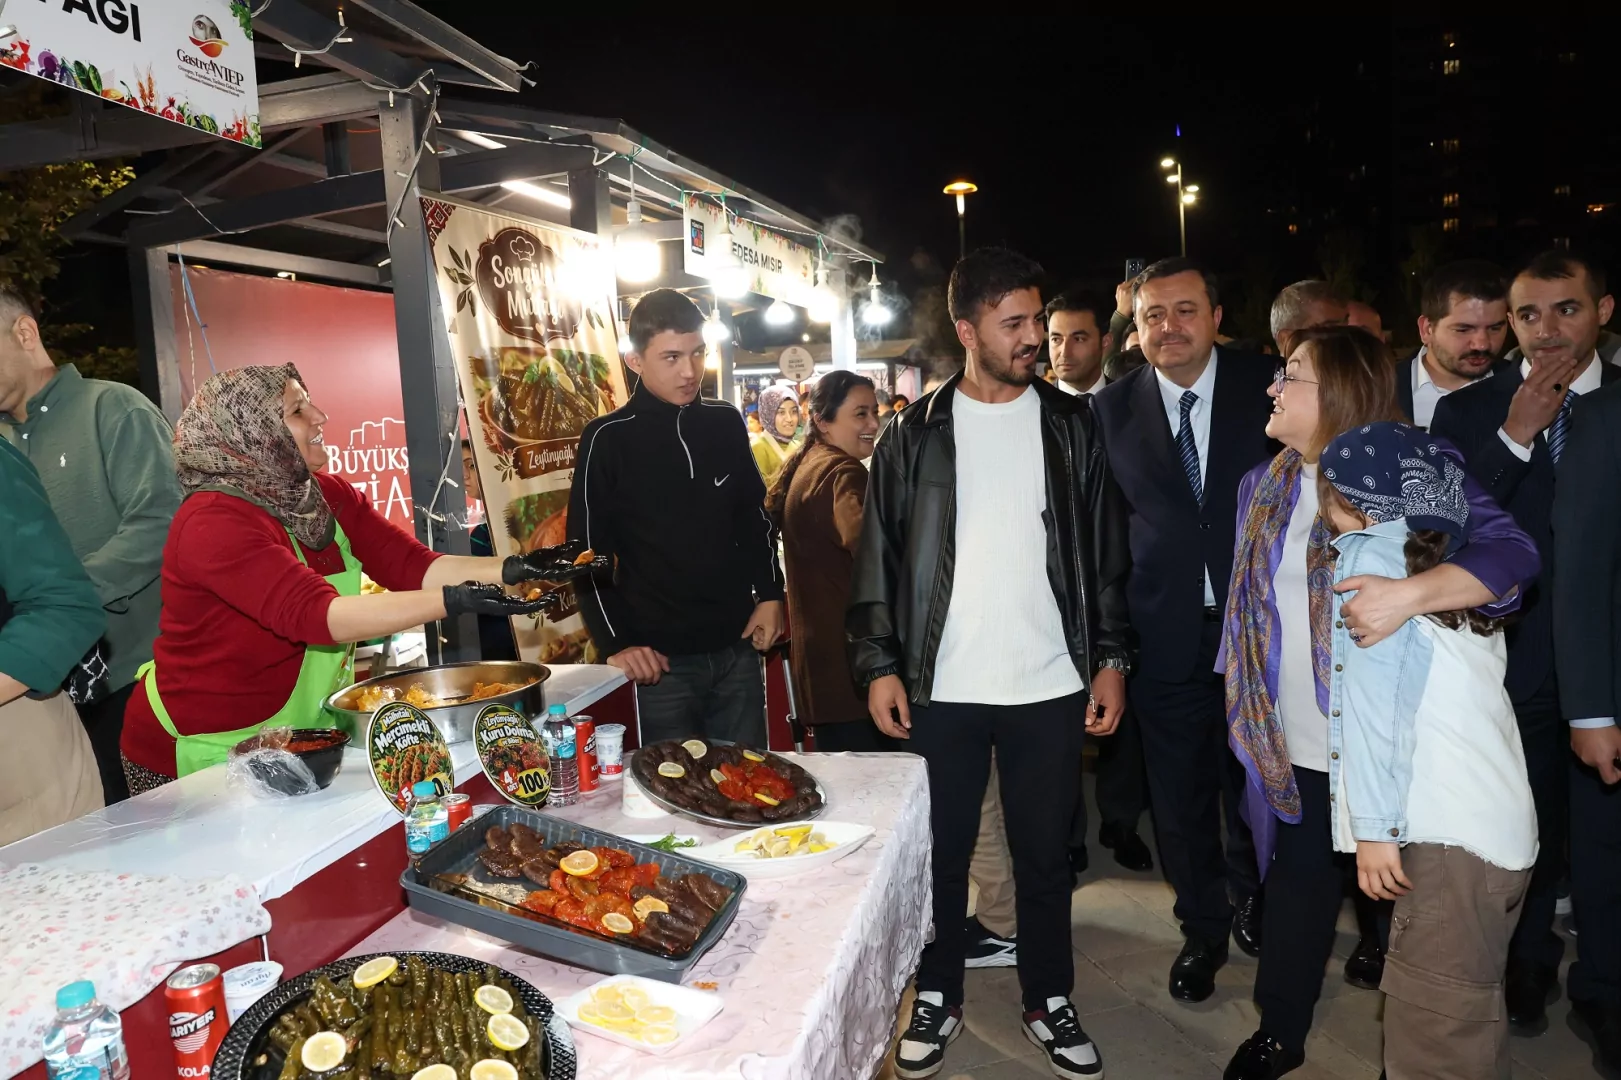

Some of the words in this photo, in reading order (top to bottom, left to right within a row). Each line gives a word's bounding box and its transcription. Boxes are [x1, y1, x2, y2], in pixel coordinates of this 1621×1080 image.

[526, 444, 575, 470] Zeytinyağlı
[374, 719, 432, 754] Mercimekli
[395, 734, 420, 752] Köfte
[480, 728, 505, 745] Kuru
[504, 725, 536, 740] Dolma
[504, 770, 513, 784] 4
[400, 786, 413, 802] 5
[170, 1009, 215, 1038] ARIYER
[177, 1065, 211, 1078] KOLA
